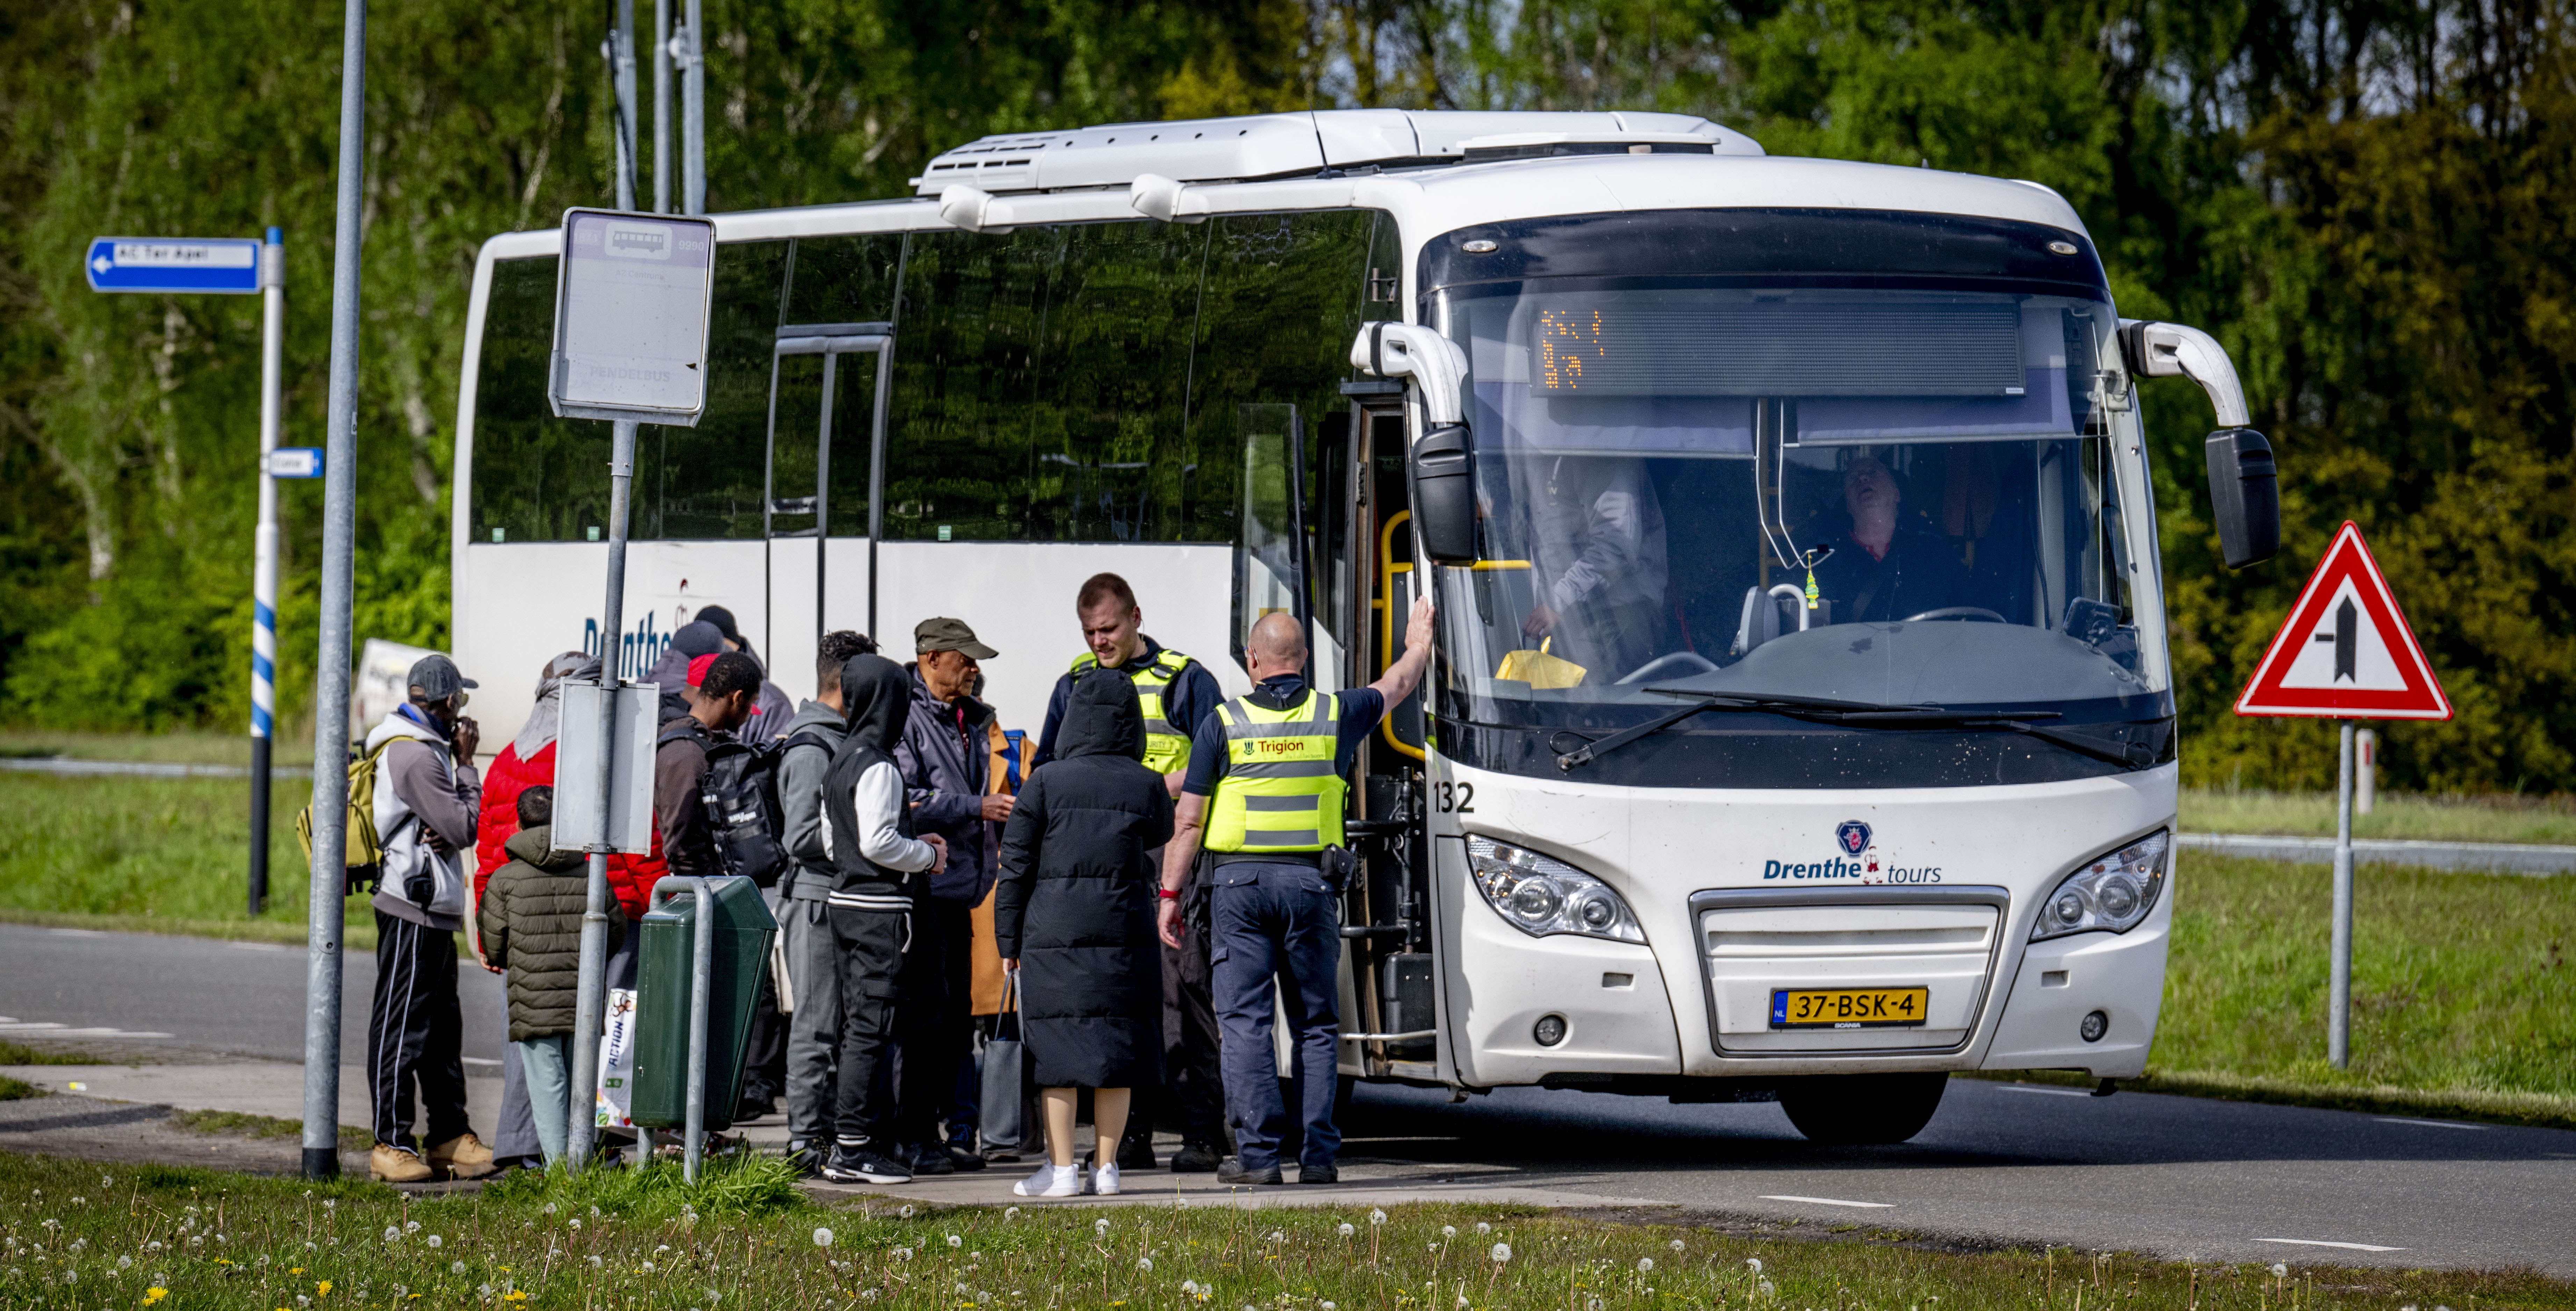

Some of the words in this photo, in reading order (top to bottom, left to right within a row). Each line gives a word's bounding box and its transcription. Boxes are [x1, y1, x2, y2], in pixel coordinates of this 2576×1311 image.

[119, 246, 139, 259] AC
[144, 246, 168, 260] Ter
[175, 247, 208, 262] Apel
[679, 240, 704, 251] 9990
[590, 366, 670, 382] PENDELBUS
[584, 609, 673, 678] Dnth
[1258, 740, 1304, 754] Trigion
[1434, 781, 1474, 813] 132
[1763, 856, 1862, 879] Drenthe
[1887, 864, 1942, 883] tours
[1796, 994, 1914, 1018] 37-BSK-4
[609, 1020, 624, 1067] ACTION
